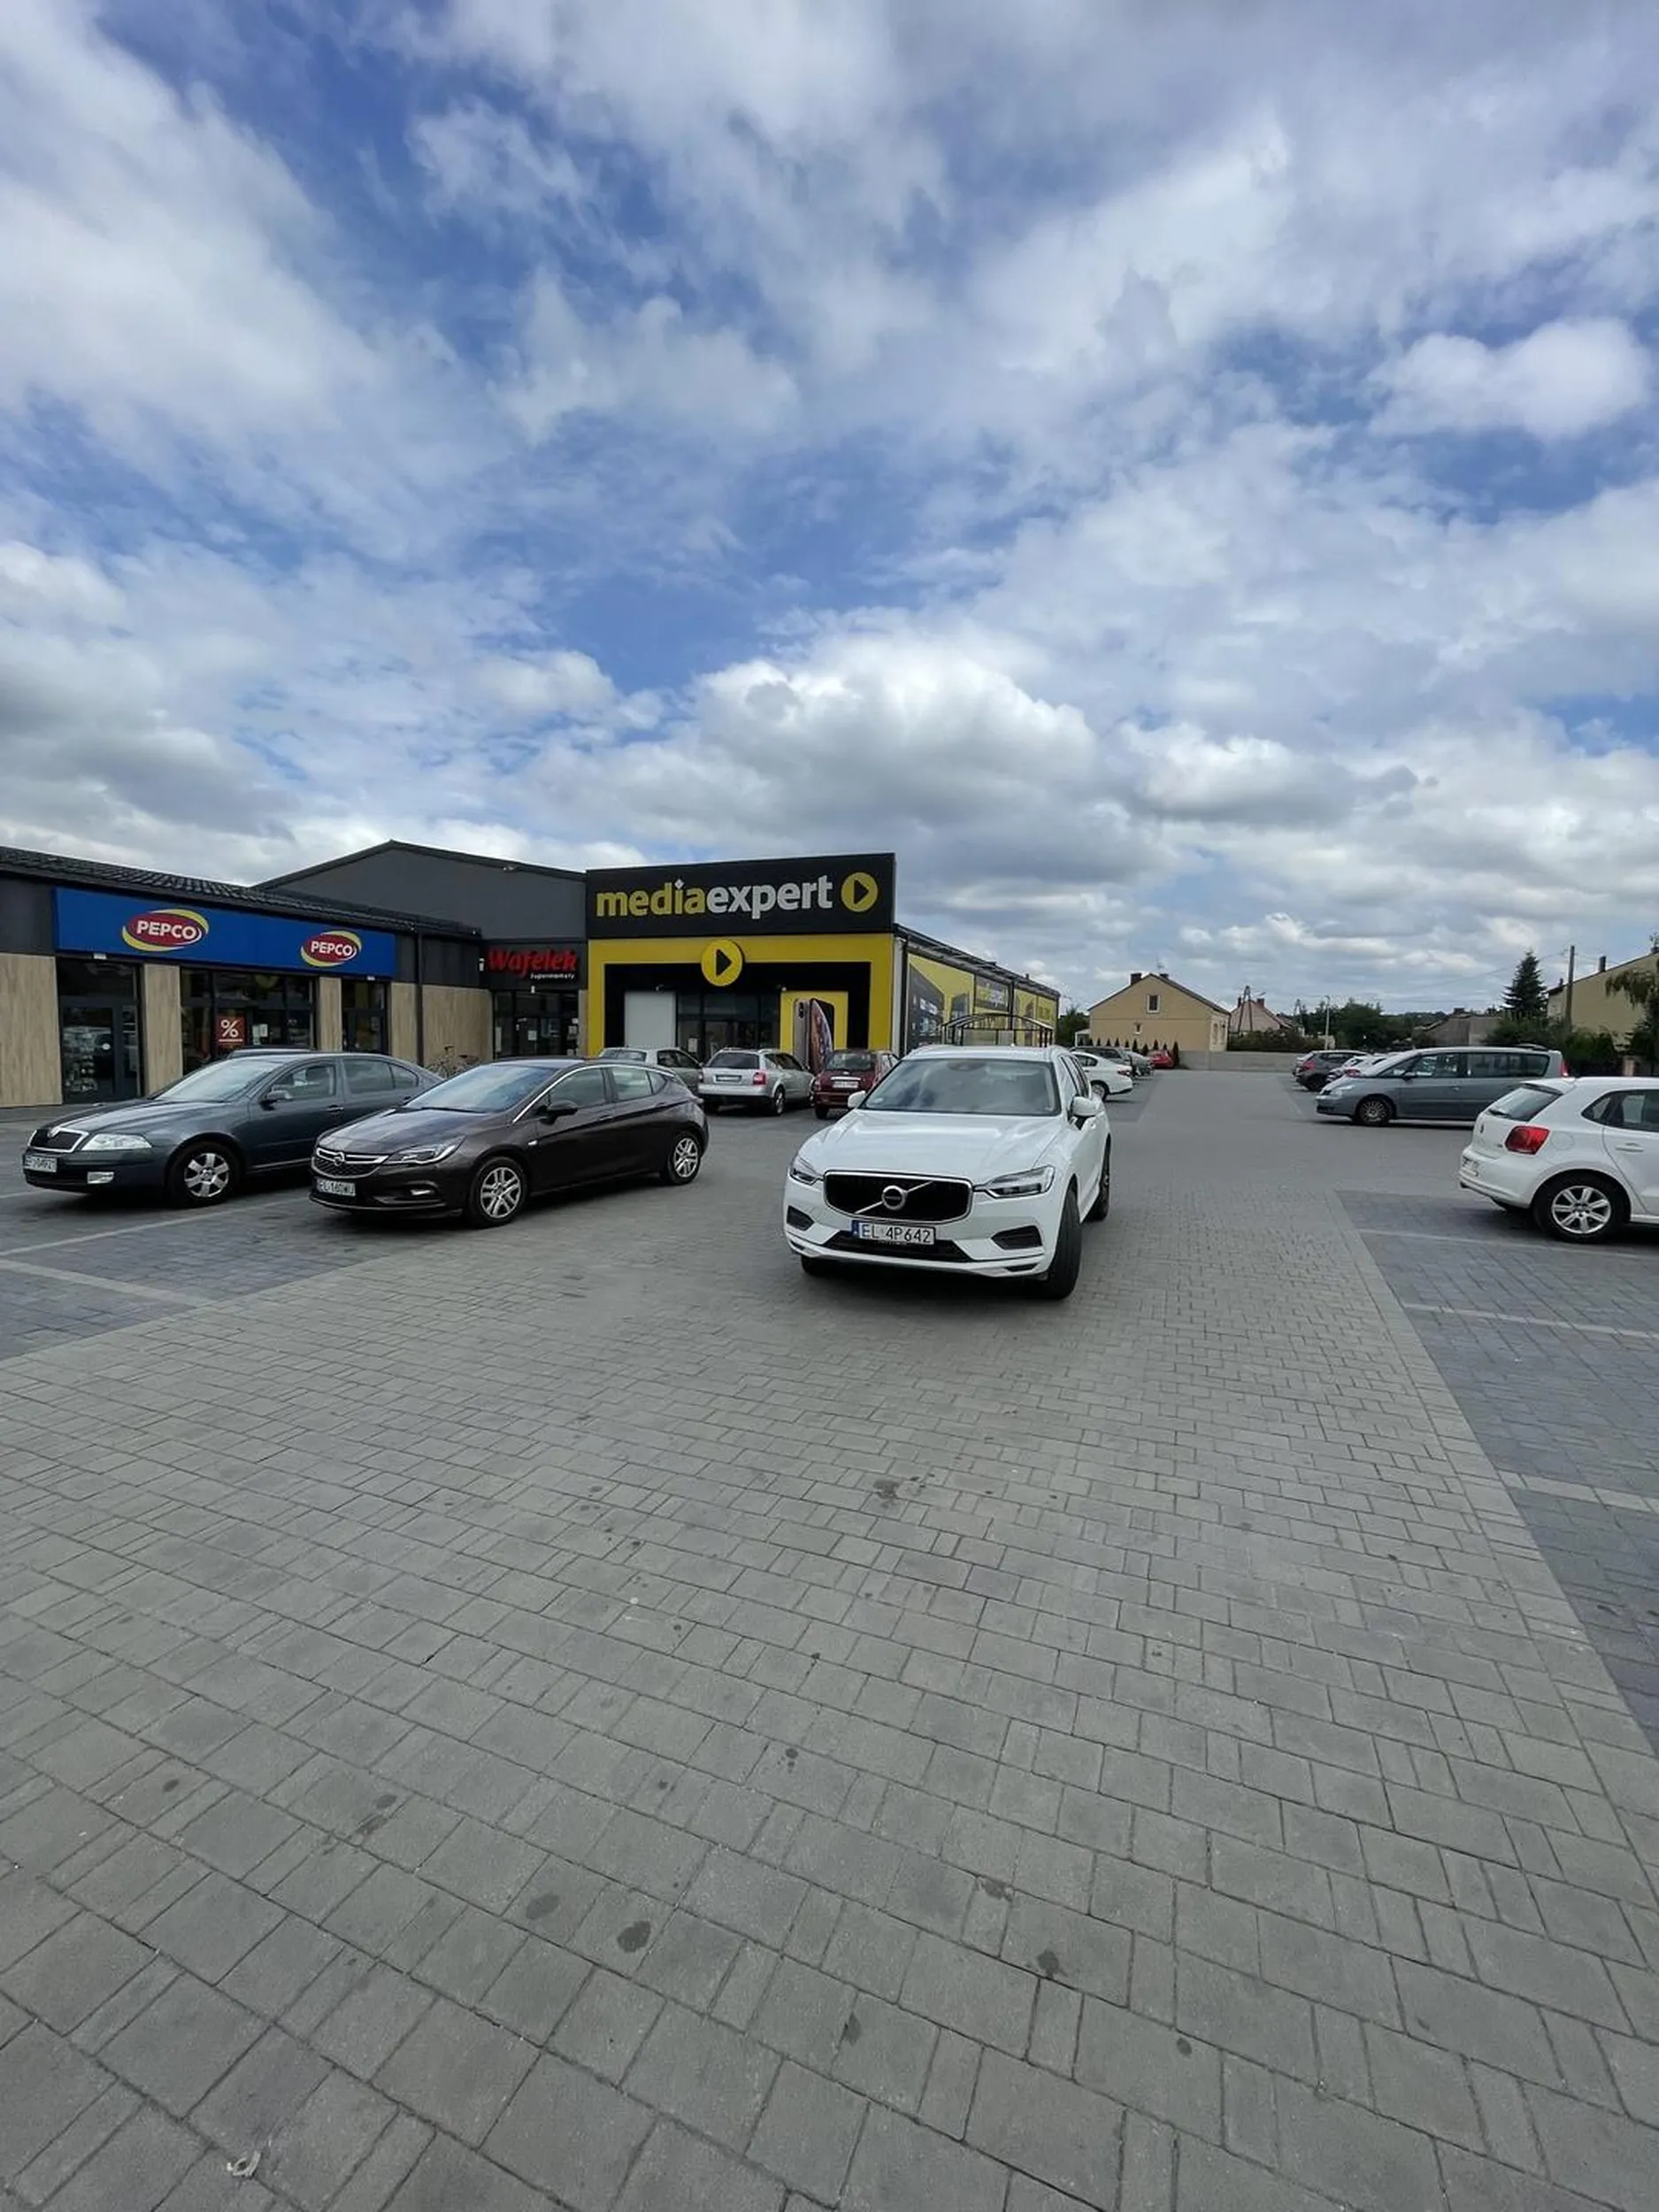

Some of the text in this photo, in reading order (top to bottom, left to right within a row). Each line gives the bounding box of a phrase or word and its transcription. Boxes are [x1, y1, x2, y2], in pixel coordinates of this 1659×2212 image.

[595, 874, 833, 919] mediaexpert
[135, 919, 197, 940] PEPCO
[311, 941, 353, 956] PEPCO
[488, 948, 577, 978] Wafelek
[220, 1018, 239, 1038] %
[861, 1224, 931, 1243] EL 4P642
